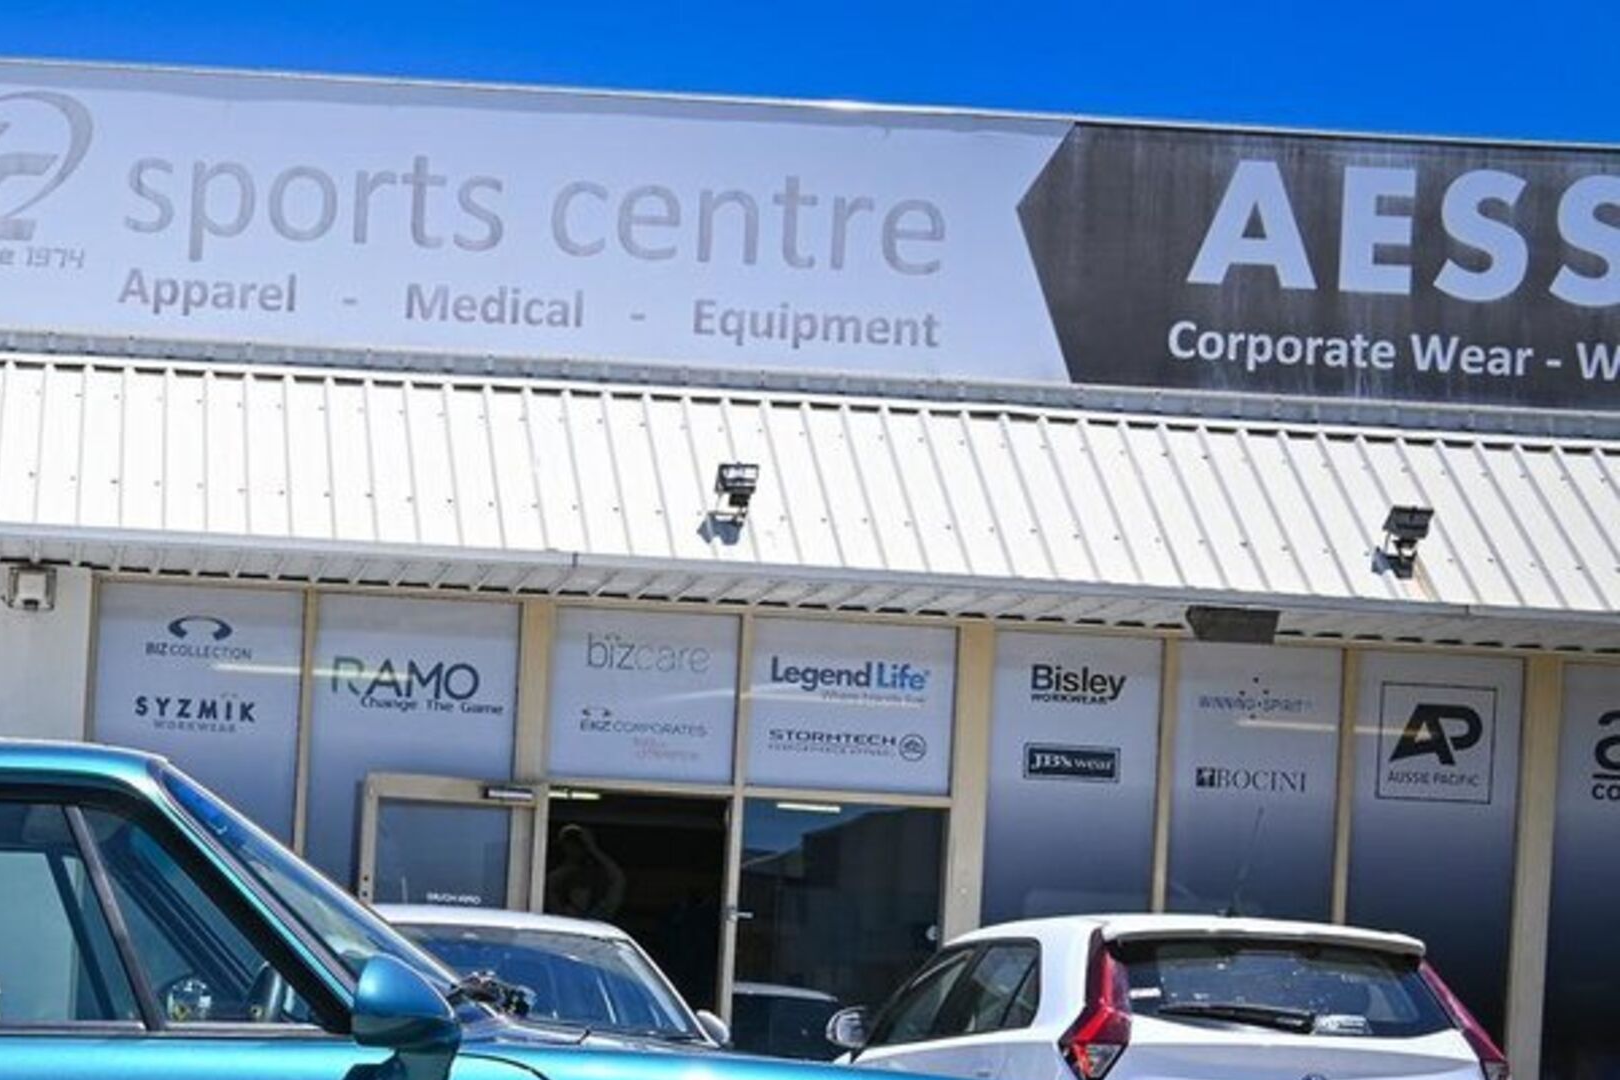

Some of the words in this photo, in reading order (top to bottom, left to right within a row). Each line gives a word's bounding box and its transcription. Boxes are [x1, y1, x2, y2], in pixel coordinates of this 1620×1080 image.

[123, 155, 504, 262] sports
[551, 175, 946, 276] centre
[1186, 158, 1620, 307] AESS
[26, 247, 86, 269] 1974
[118, 267, 297, 316] Apparel
[405, 283, 584, 328] Medical
[693, 299, 940, 350] Equipment
[1168, 320, 1396, 371] Corporate
[1410, 333, 1534, 377] Wear
[586, 632, 711, 674] bizcare
[332, 656, 480, 701] RAMO
[771, 655, 873, 692] Legend
[876, 661, 926, 691] Life
[1031, 663, 1127, 700] Bisley
[134, 695, 256, 722] SYZMIK
[361, 697, 417, 712] Change
[426, 700, 454, 713] The
[460, 702, 504, 715] Game
[768, 727, 897, 746] STORMTECH
[1388, 703, 1483, 767] AP
[1217, 767, 1307, 793] BOCINI
[1387, 770, 1430, 785] AUSSIE
